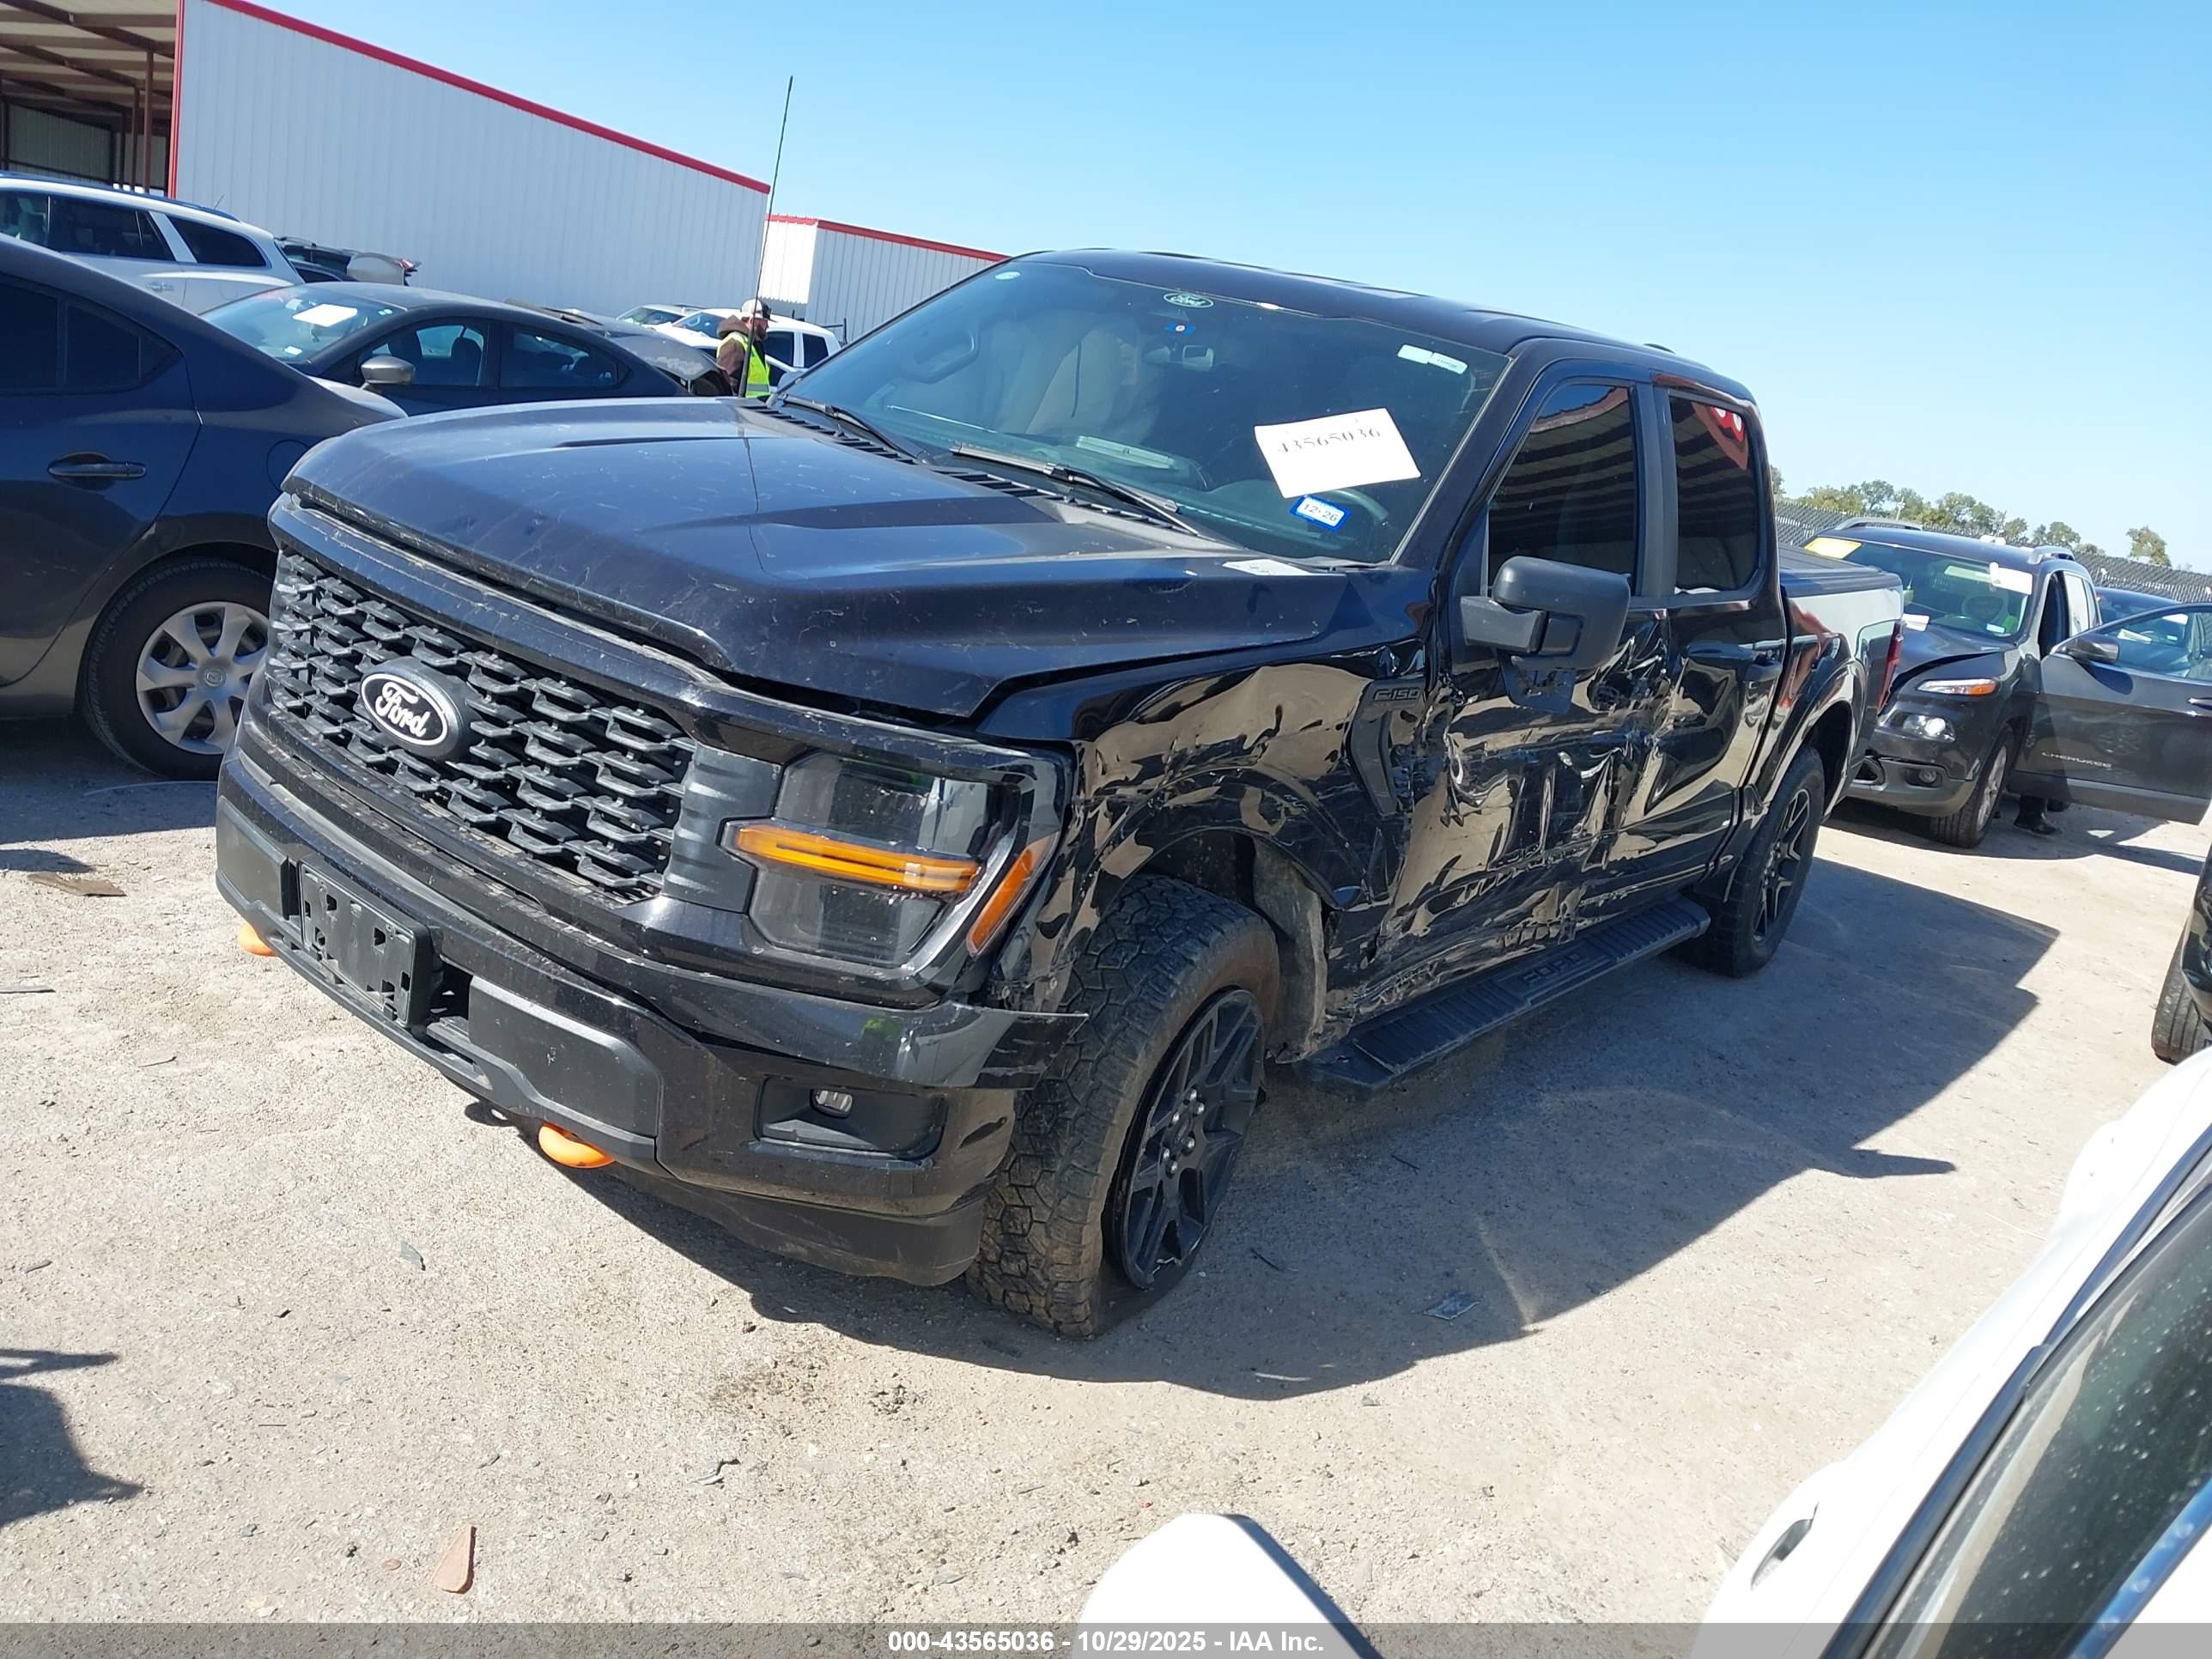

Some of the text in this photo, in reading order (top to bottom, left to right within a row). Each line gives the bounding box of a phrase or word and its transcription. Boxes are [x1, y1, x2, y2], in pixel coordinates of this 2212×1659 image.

[1278, 428, 1381, 453] 43565036
[1373, 687, 1421, 702] F-150
[375, 681, 430, 737] Ford
